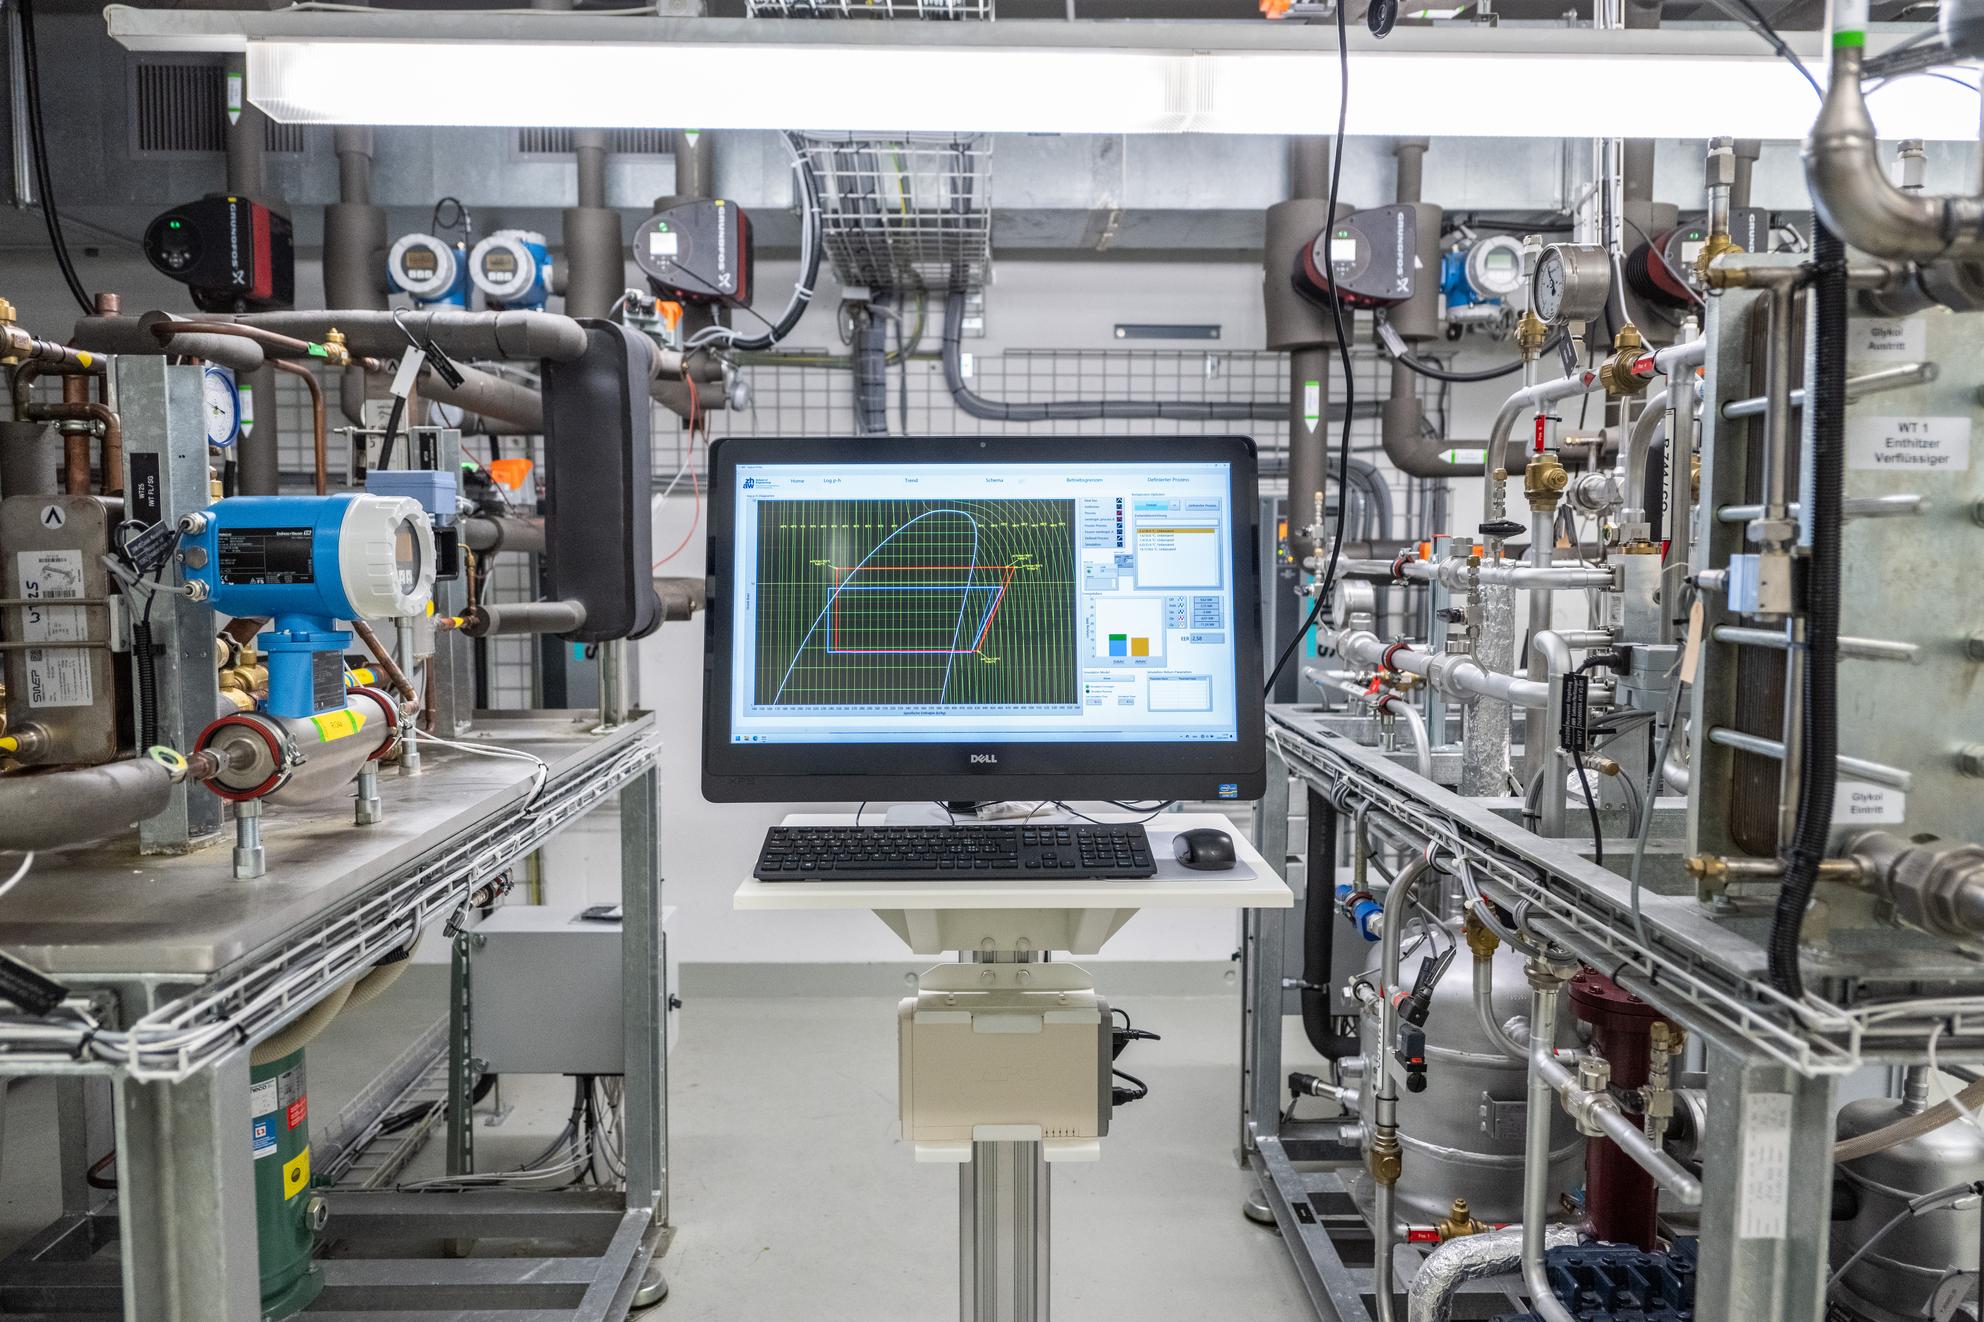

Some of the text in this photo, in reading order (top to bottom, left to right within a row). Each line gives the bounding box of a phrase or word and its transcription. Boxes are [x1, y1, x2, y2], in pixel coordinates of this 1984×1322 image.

[229, 203, 239, 269] GRUNDFOS
[1748, 213, 1756, 253] GRUND
[718, 206, 726, 272] GRUNDFOS
[1397, 211, 1405, 276] GRUNDFOS
[1871, 327, 1904, 338] Glykol
[1868, 341, 1906, 351] Austritt
[1898, 422, 1929, 433] WT 1
[1885, 437, 1941, 449] Enthitzer
[1874, 452, 1950, 466] Verflüssiger
[970, 754, 998, 764] DELL
[1851, 792, 1884, 803] Glykol
[1850, 805, 1884, 814] Eintritt
